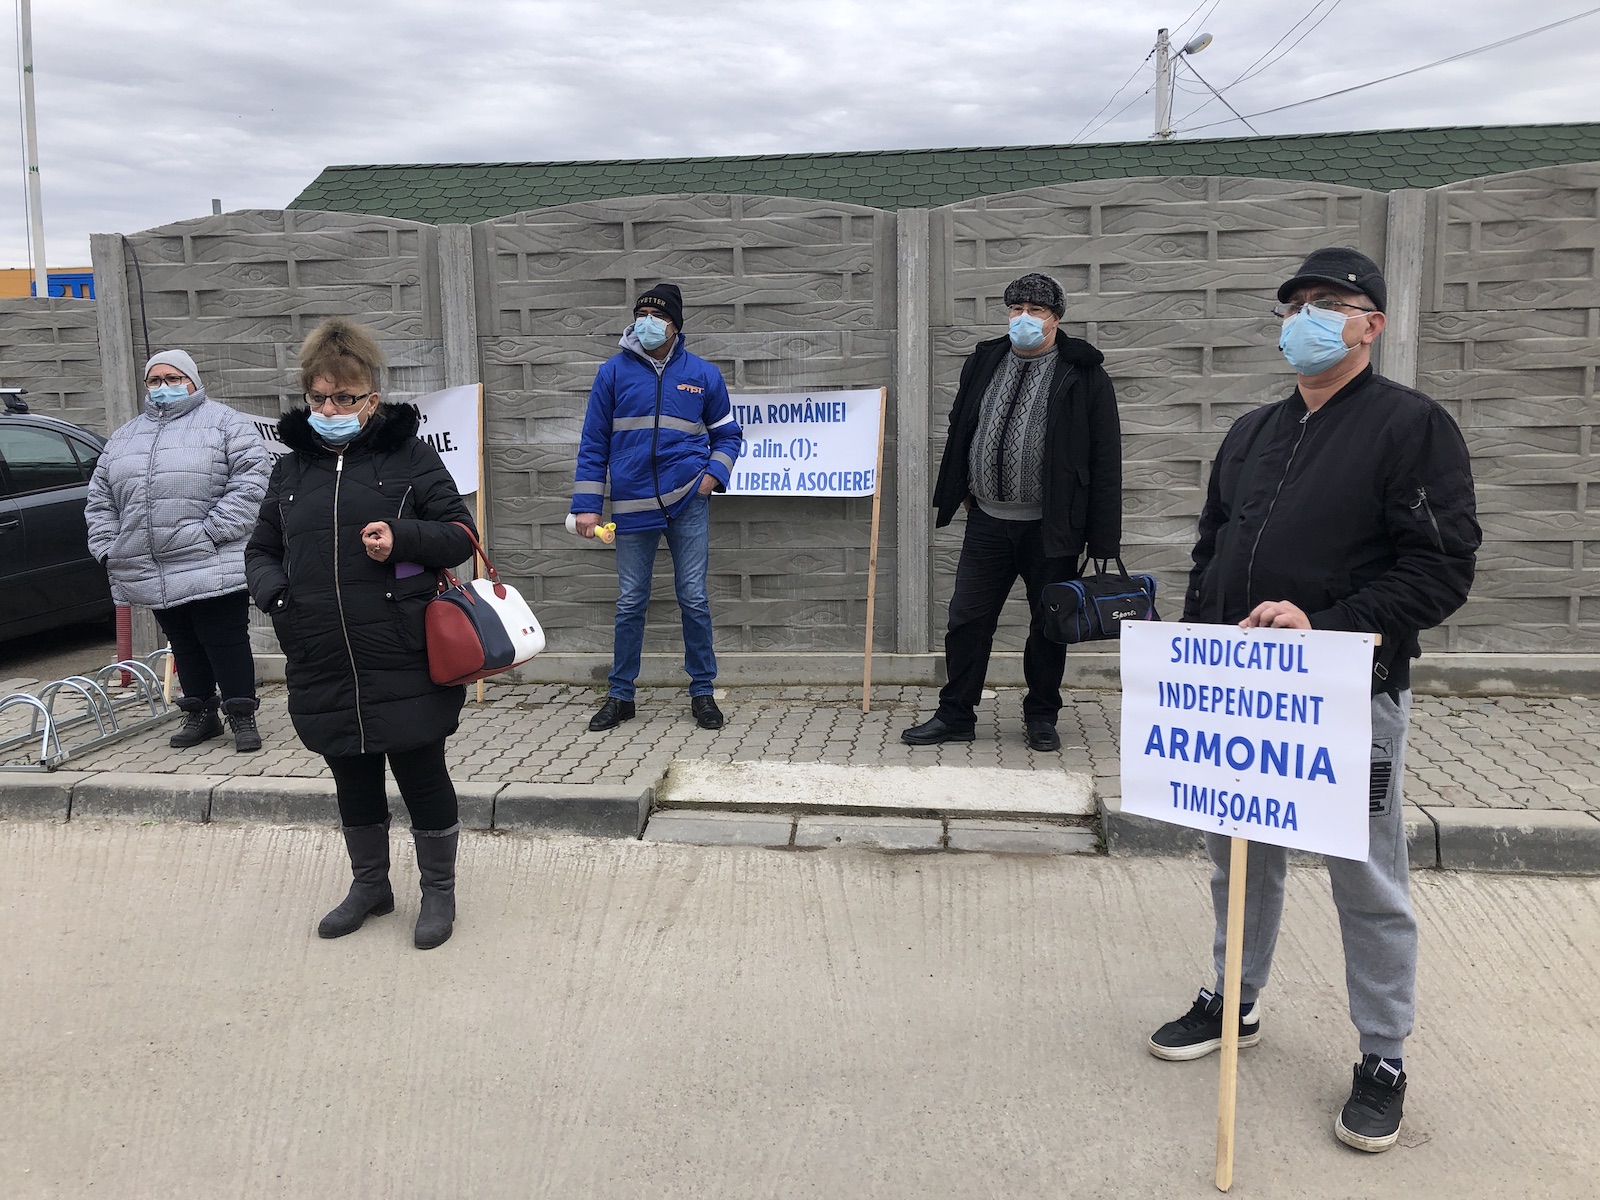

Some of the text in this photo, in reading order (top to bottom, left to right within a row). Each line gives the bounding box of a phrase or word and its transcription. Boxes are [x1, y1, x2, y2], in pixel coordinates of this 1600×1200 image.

[767, 397, 846, 424] ROMÂNIEI
[736, 467, 792, 491] LIBERĂ
[795, 468, 875, 492] ASOCIERE!
[1170, 636, 1309, 674] SINDICATUL
[1158, 681, 1324, 725] INDEPENDENT
[1144, 724, 1337, 785] ARMONIA
[1170, 781, 1298, 832] TIMIȘOARA
